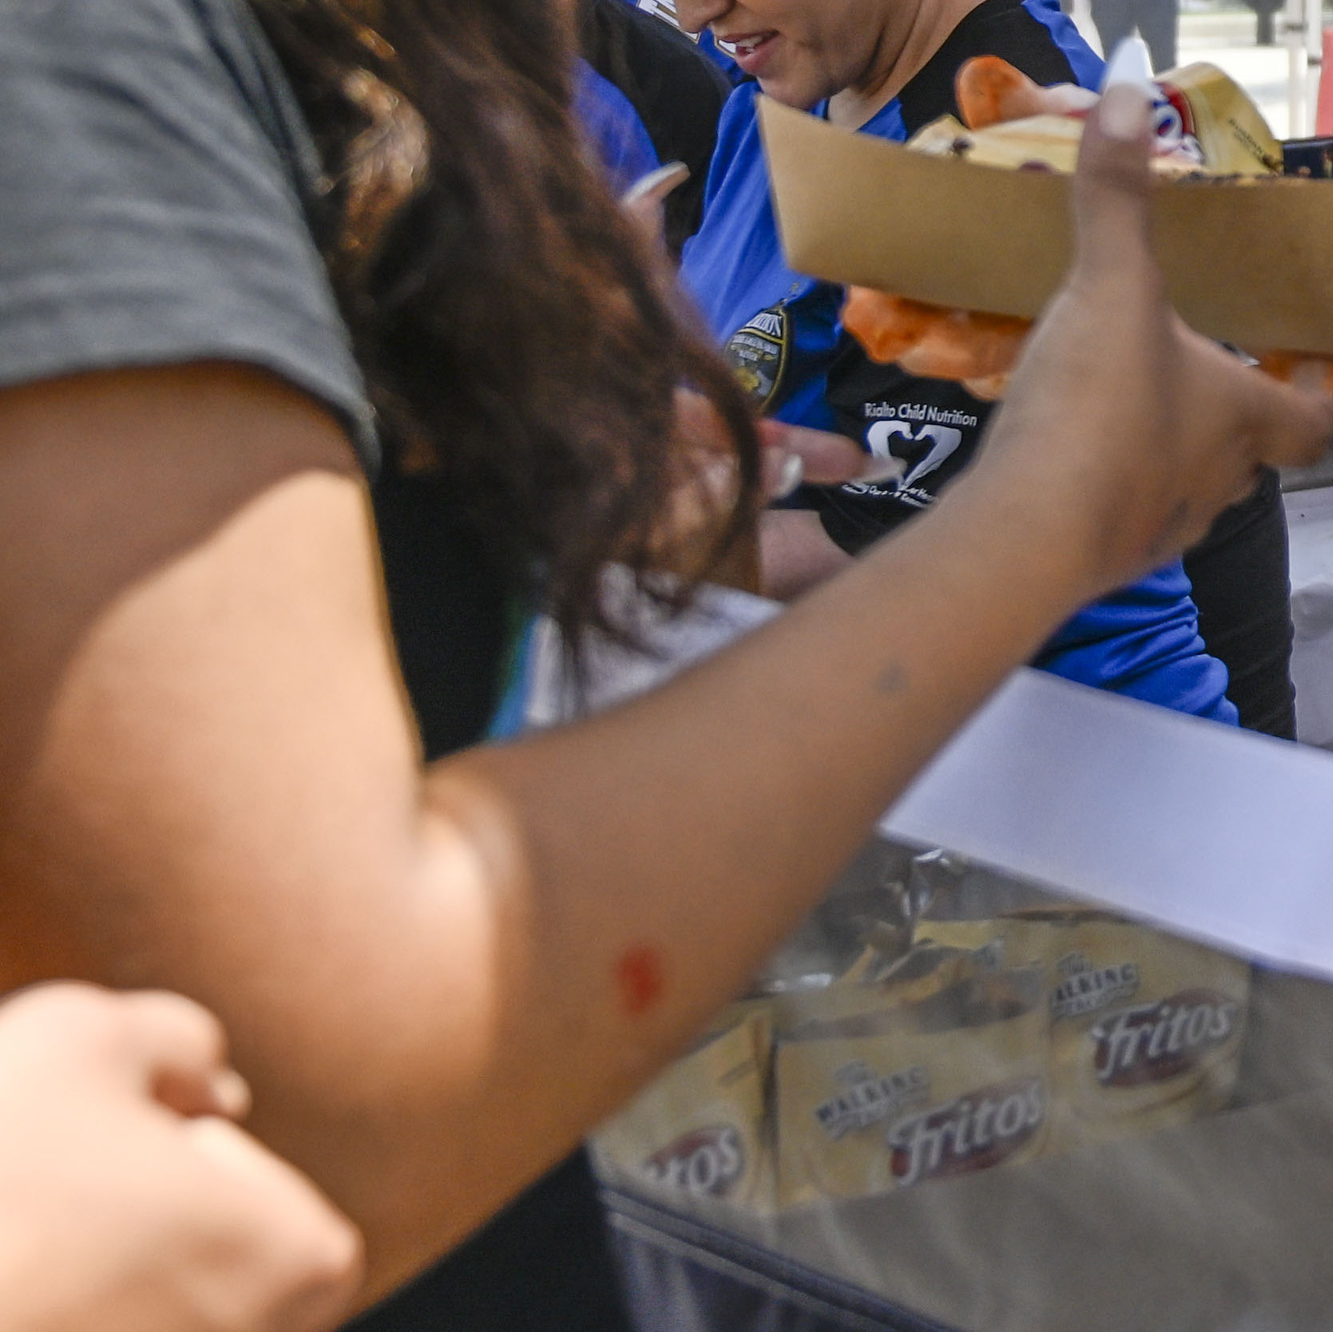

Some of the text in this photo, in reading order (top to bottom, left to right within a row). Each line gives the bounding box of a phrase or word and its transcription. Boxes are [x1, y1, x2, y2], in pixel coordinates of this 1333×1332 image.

[864, 401, 978, 427] Rialto Child Nutrition
[1091, 1000, 1234, 1079] Fritos
[887, 1079, 1042, 1187] Fritos
